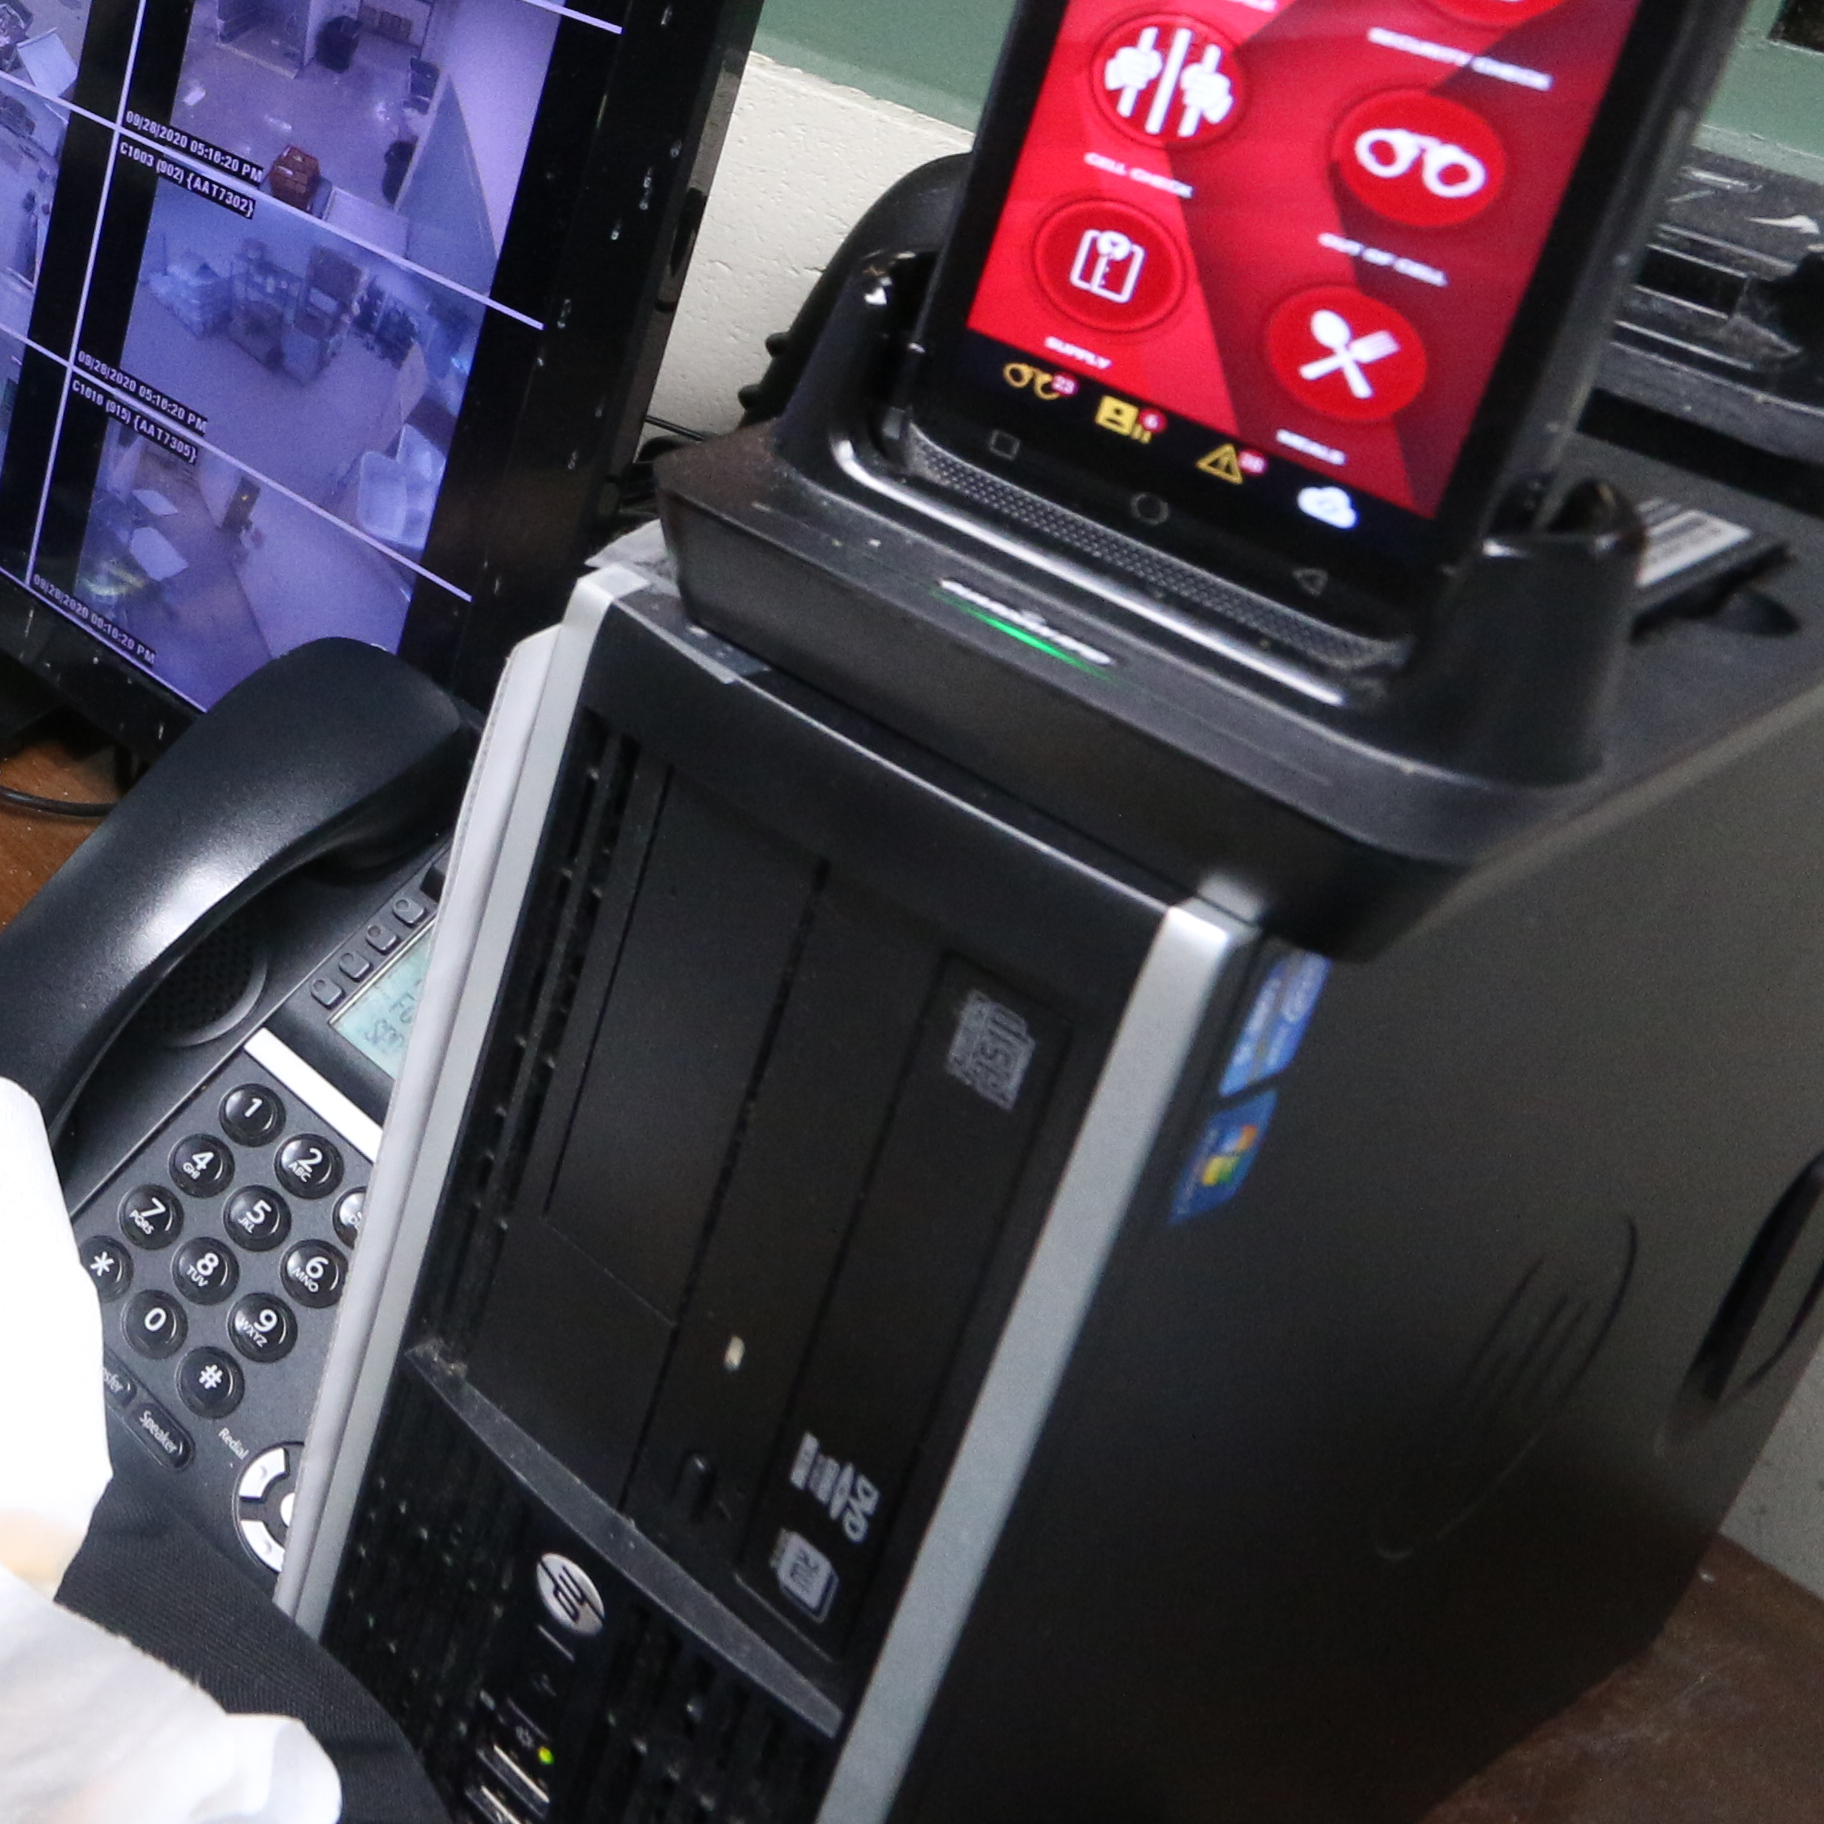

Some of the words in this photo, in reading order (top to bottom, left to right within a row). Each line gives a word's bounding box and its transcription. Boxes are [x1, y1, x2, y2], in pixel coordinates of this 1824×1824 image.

[1367, 27, 1472, 66] SECURITY
[1473, 55, 1553, 92] CHECK
[125, 110, 188, 149] 09/28/2020
[241, 163, 264, 184] PM
[1084, 152, 1128, 176] CELL
[1129, 168, 1194, 199] CHECK
[186, 172, 254, 218] {AAT7302}
[1317, 232, 1364, 256] OUT
[1362, 248, 1395, 266] OF
[1394, 257, 1448, 287] CELL
[1044, 335, 1113, 370] SUPPLY
[77, 350, 137, 393] 09/28/2020
[187, 412, 208, 435] PM
[136, 643, 156, 665] PM
[244, 1098, 263, 1118] 1
[182, 1161, 201, 1181] GHI
[192, 1151, 214, 1171] 4
[288, 1160, 312, 1183] ABC
[298, 1148, 324, 1173] 2
[141, 1197, 167, 1218] 7
[246, 1200, 272, 1224] 5
[129, 1209, 155, 1236] PQRS
[237, 1216, 255, 1234] JKL
[186, 1265, 209, 1288] TUV
[196, 1252, 220, 1277] 8
[305, 1256, 329, 1280] 6
[291, 1266, 320, 1294] MNO
[144, 1307, 168, 1332] 0
[238, 1315, 268, 1348] WXYZ
[253, 1308, 278, 1333] 9
[198, 1363, 224, 1390] #
[139, 1409, 178, 1455] Speaker
[217, 1427, 250, 1460] Redial
